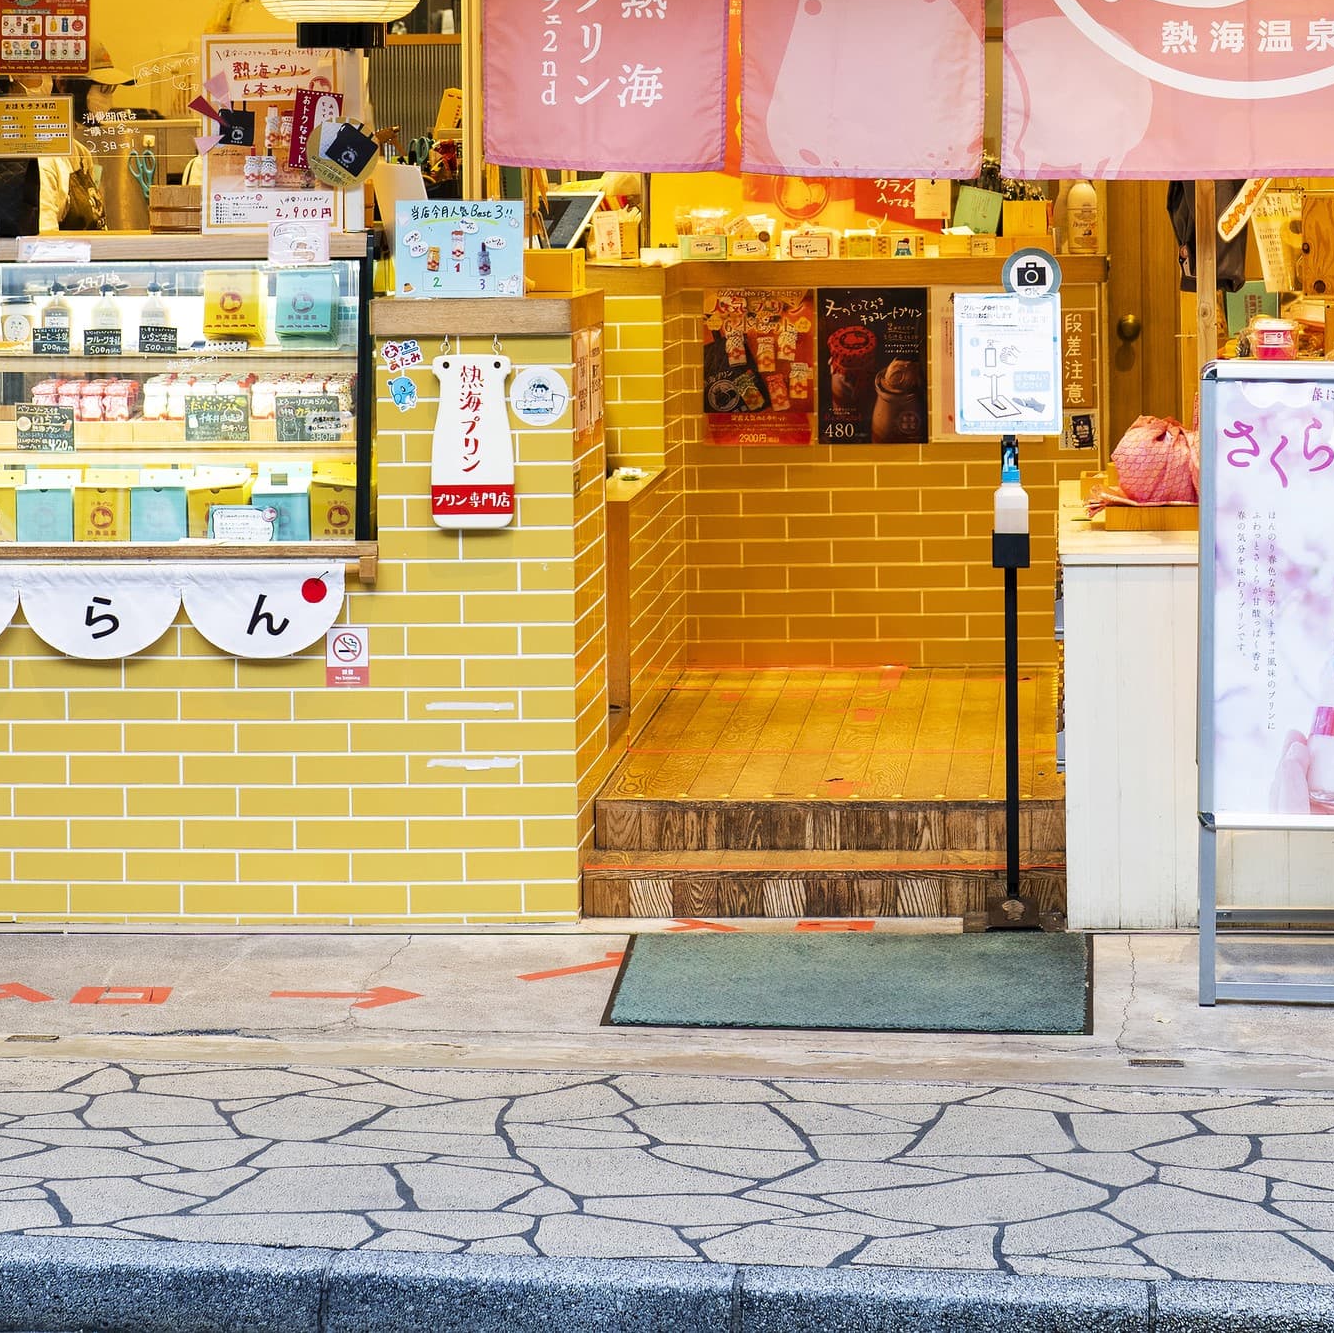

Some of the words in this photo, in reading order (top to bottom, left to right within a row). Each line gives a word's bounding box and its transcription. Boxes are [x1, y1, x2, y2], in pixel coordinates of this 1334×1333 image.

[232, 61, 311, 80] 熱海プリン
[243, 81, 299, 98] 6本セッ
[297, 95, 312, 164] おトクなセット
[275, 206, 333, 219] 2,900円
[453, 262, 461, 273] 1
[433, 276, 443, 288] 2
[479, 278, 486, 290] 3
[859, 306, 923, 326] チョコレートプリン
[388, 352, 422, 371] あたみ
[1064, 312, 1086, 405] 段差注意
[459, 365, 486, 474] 熱海プリン
[824, 422, 855, 438] 480
[433, 491, 512, 509] プリン専門店
[1236, 510, 1247, 657] 春の気分を味わうプリンです。
[1252, 511, 1262, 672] ふわっとさくらが甘酸っぱく香る
